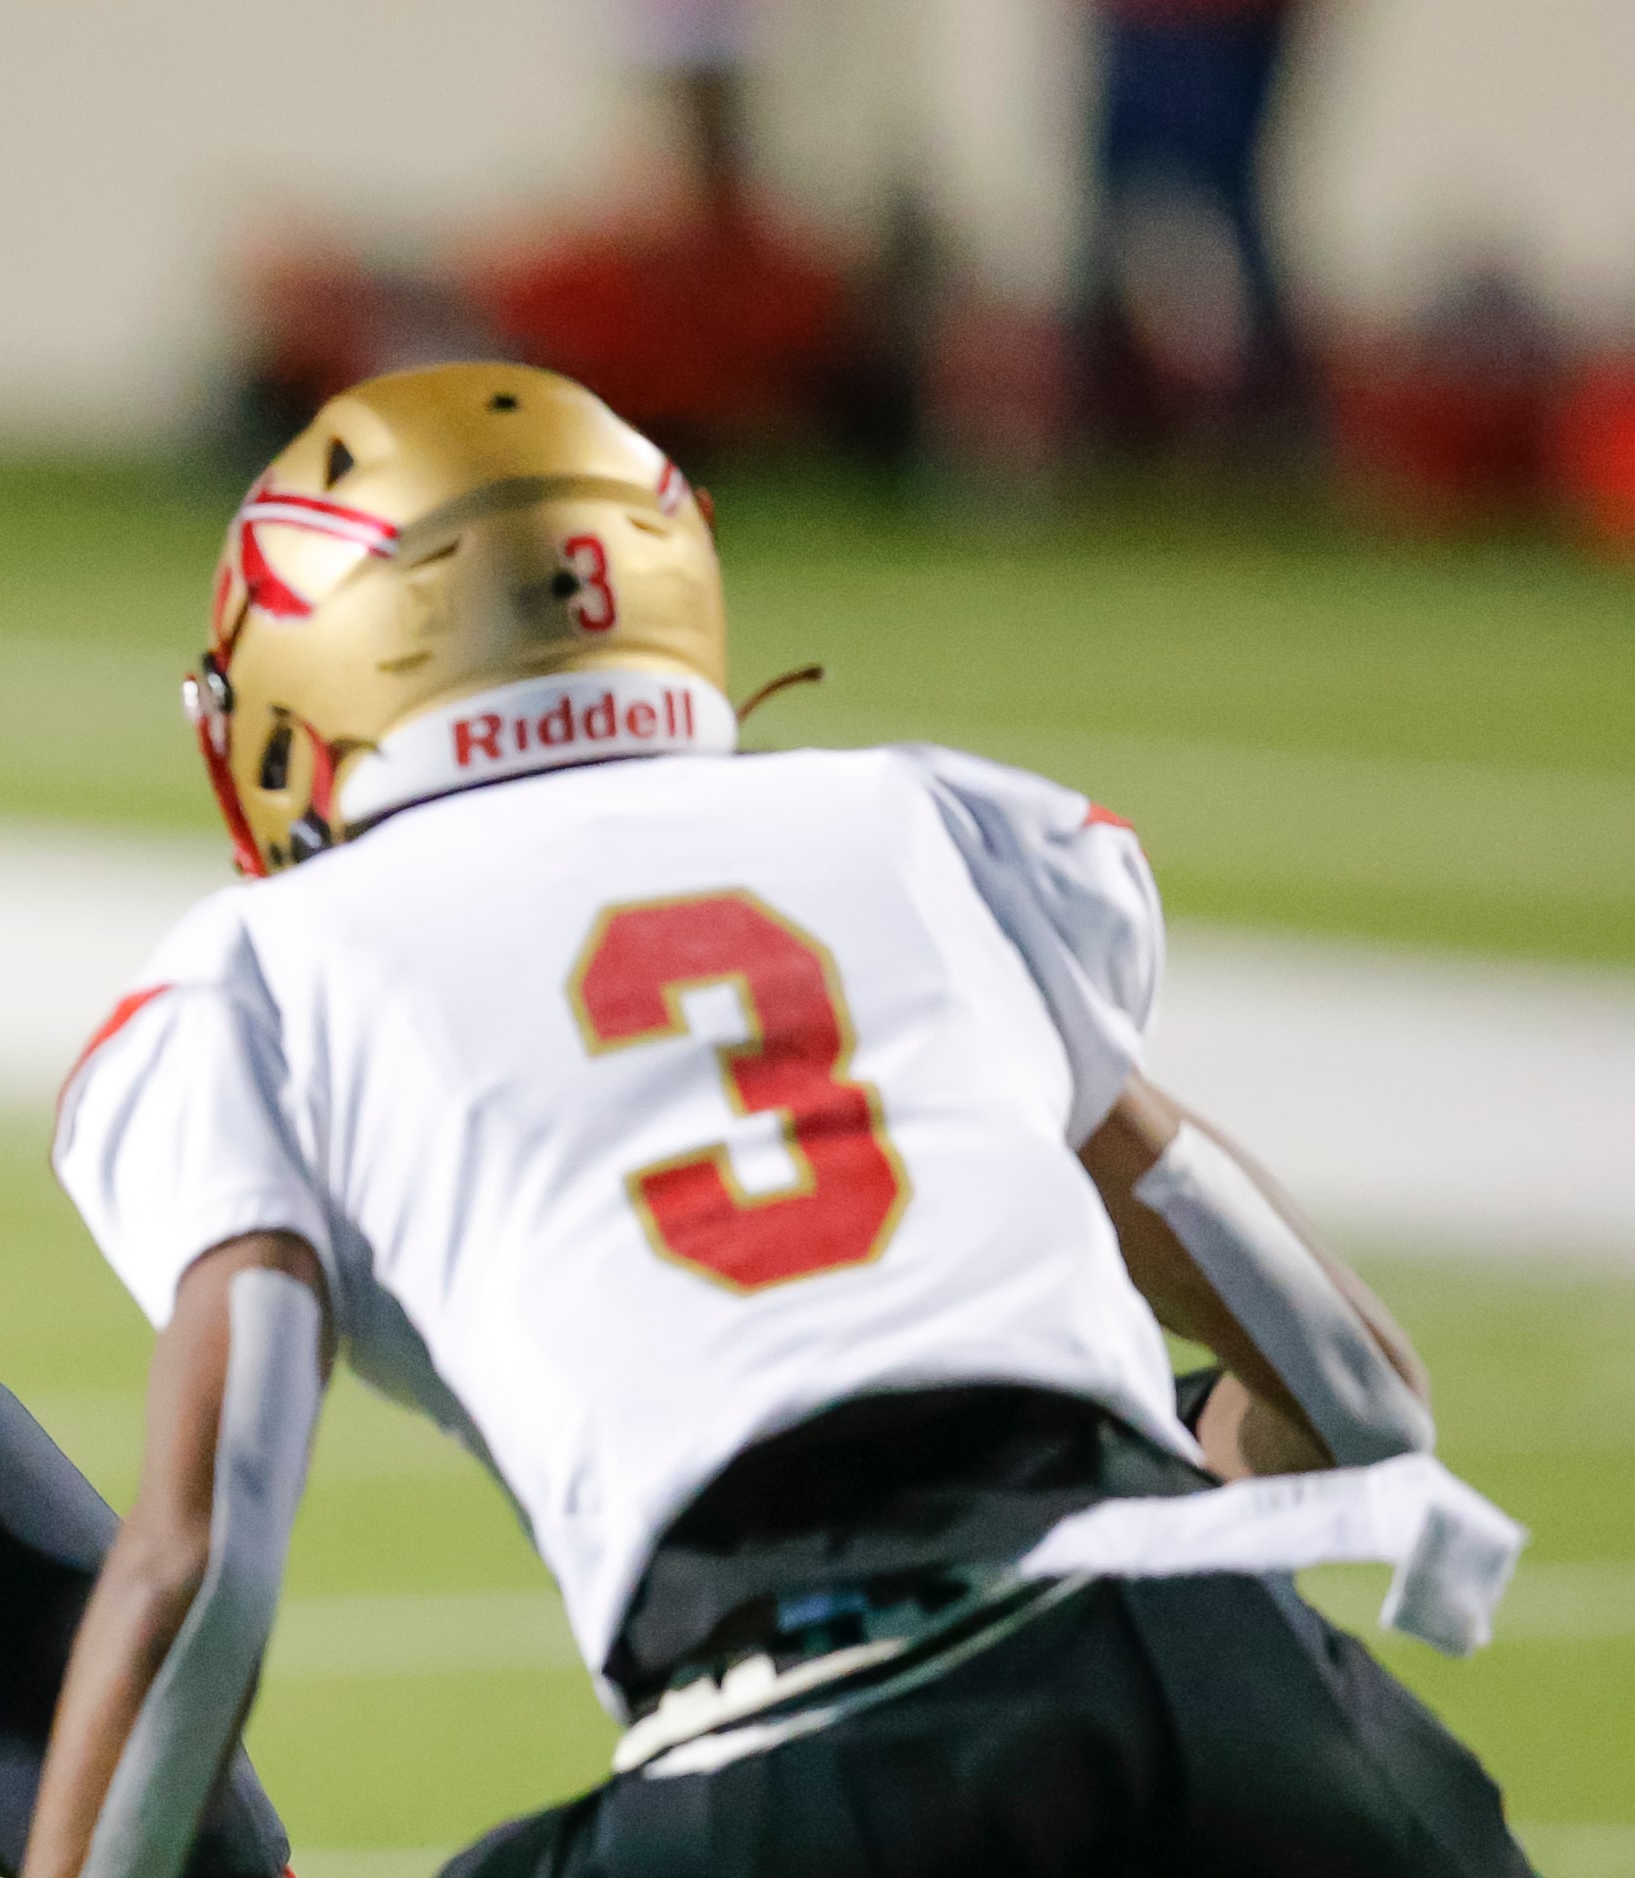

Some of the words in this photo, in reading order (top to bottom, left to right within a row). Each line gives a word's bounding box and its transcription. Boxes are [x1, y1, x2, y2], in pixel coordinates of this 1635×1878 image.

[564, 533, 616, 633] 3
[453, 689, 695, 768] Riddell
[564, 886, 914, 1297] 3
